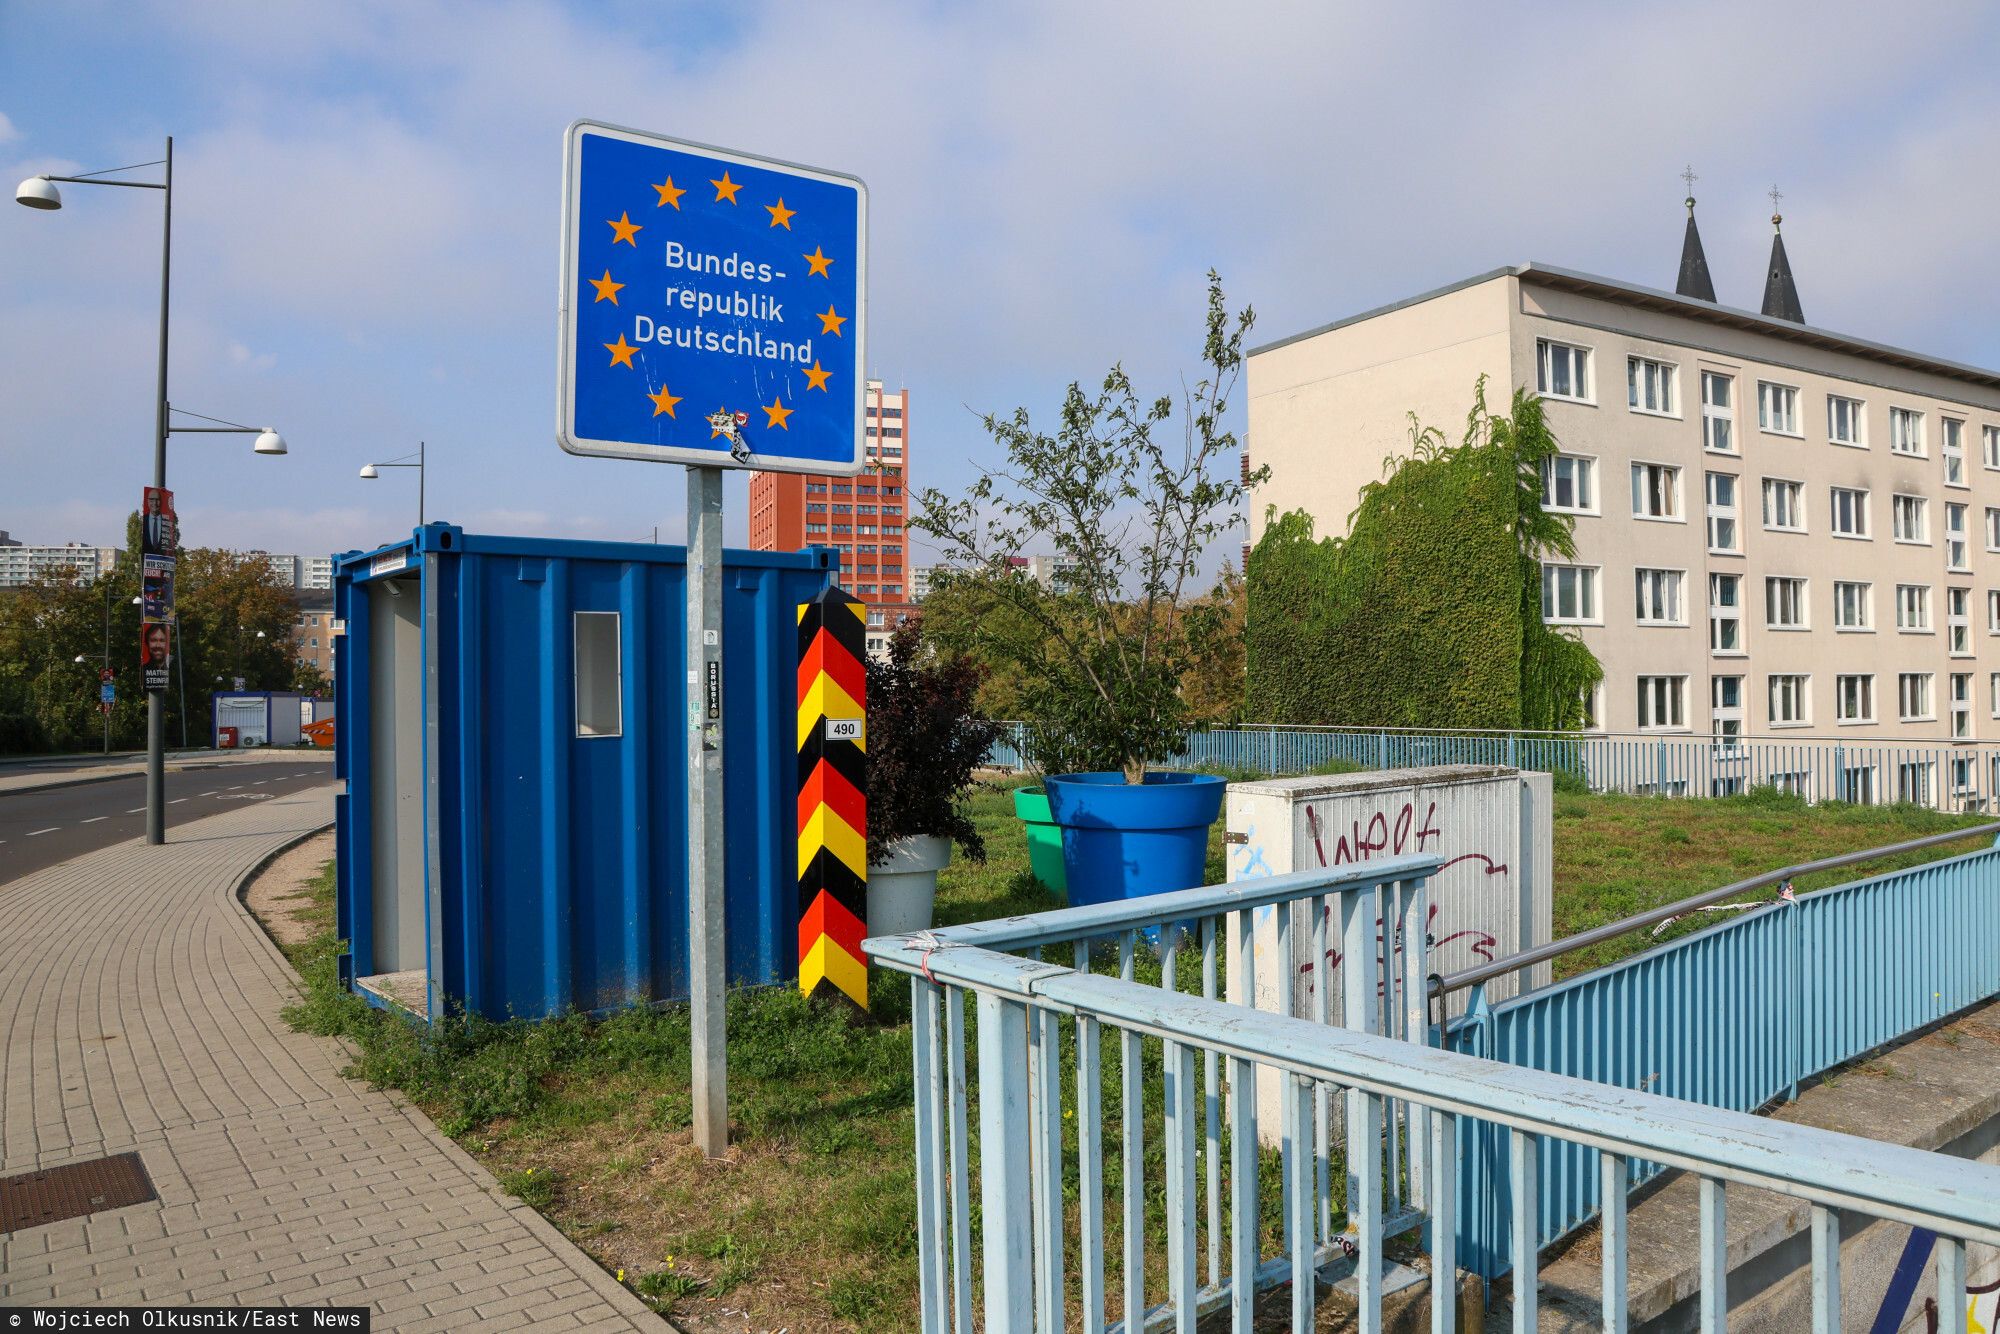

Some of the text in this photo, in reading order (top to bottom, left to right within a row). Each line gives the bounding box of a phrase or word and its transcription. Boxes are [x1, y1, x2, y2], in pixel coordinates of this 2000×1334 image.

[666, 241, 786, 281] Bundes-
[666, 287, 784, 323] republik
[635, 315, 812, 364] Deutschland
[833, 723, 855, 735] 490
